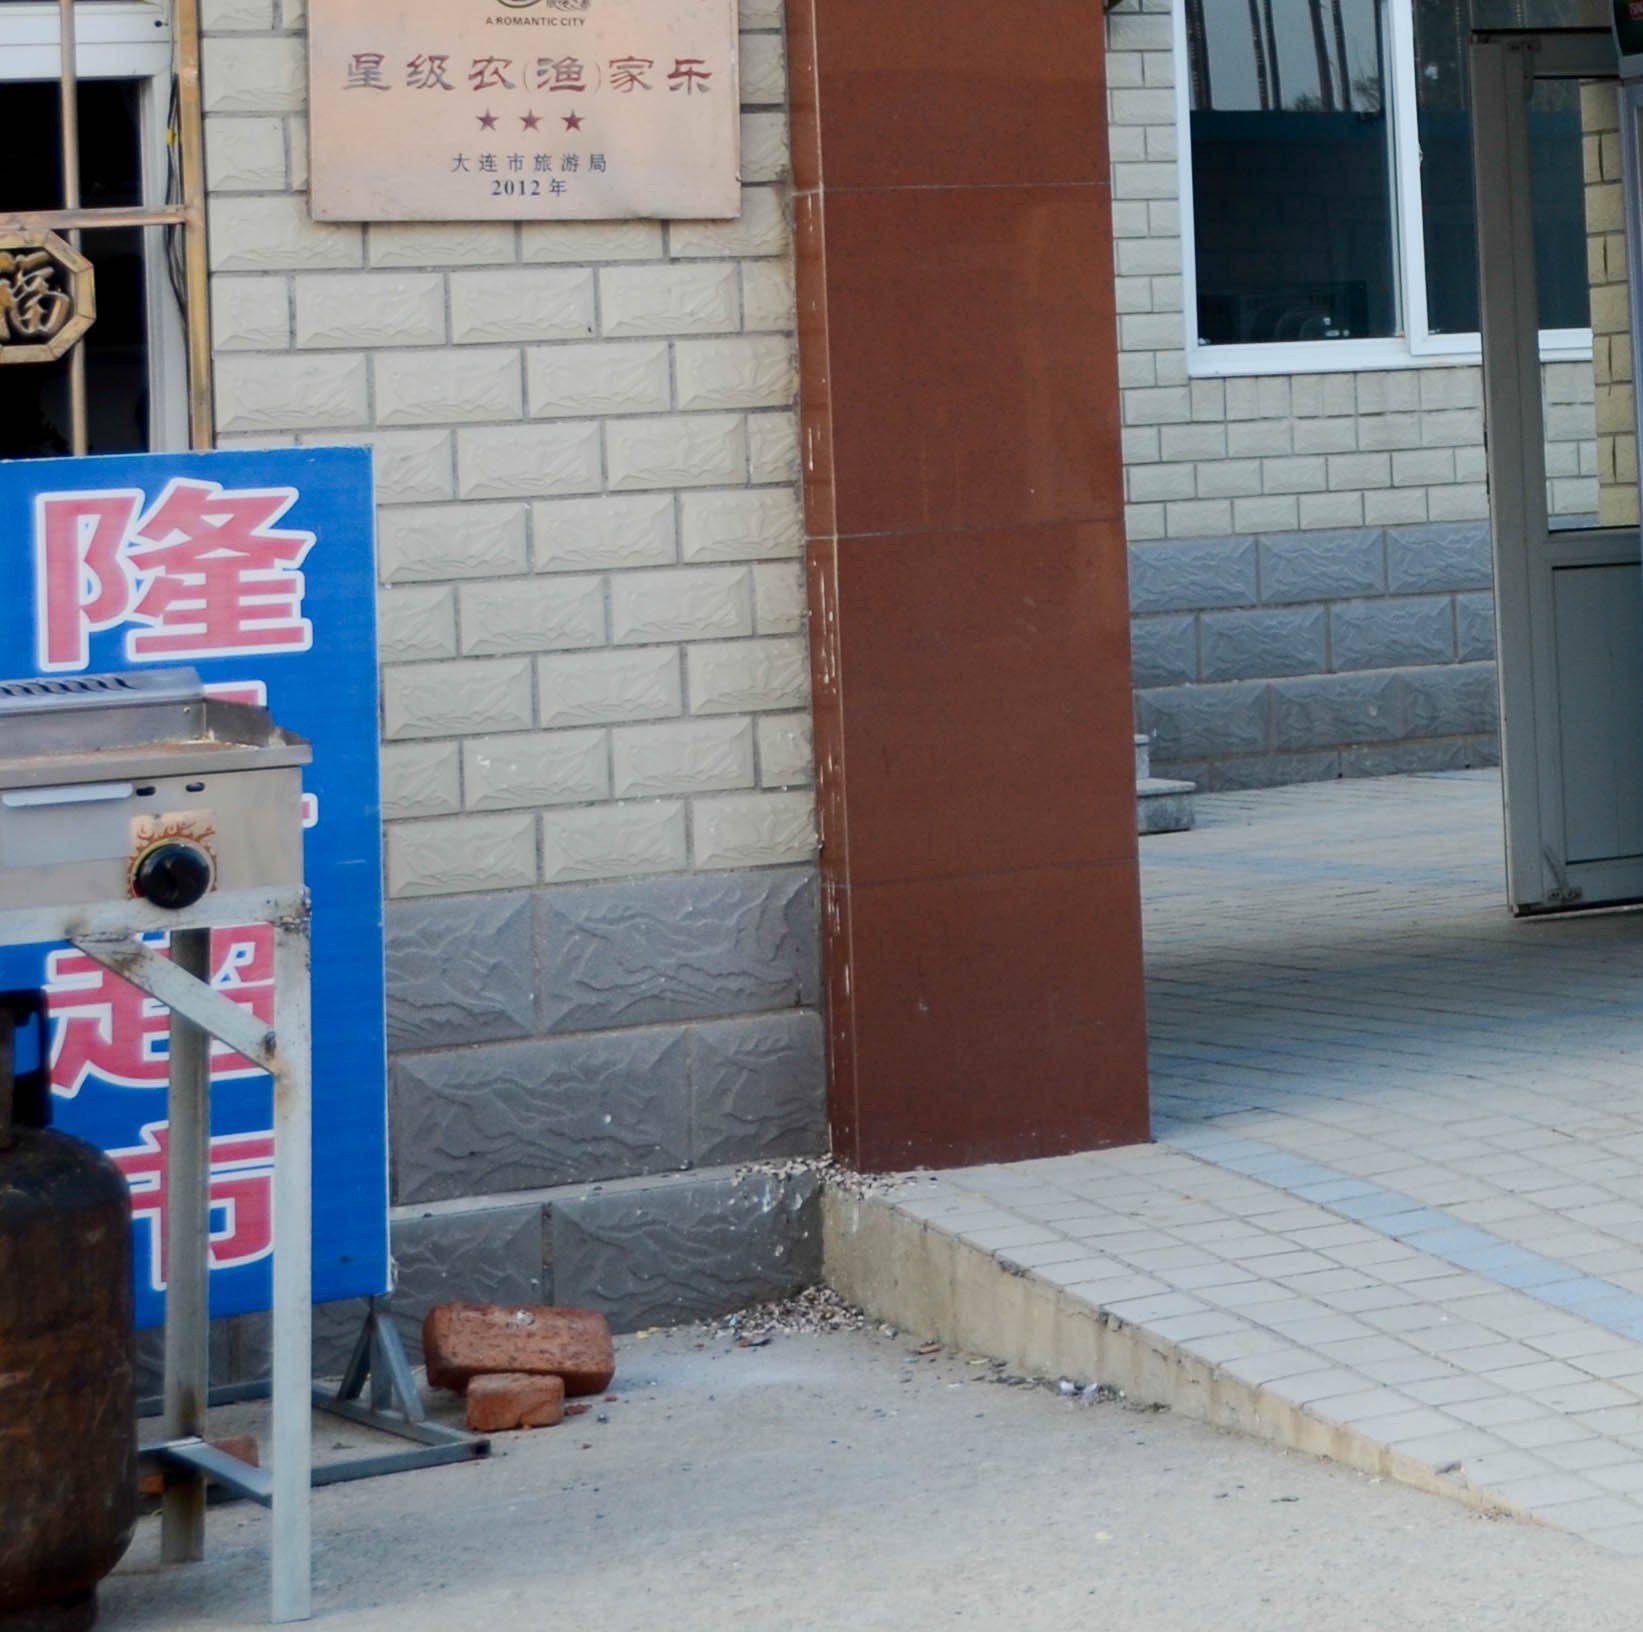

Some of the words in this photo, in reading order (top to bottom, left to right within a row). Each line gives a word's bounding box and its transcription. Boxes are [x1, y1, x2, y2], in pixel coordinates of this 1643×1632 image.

[485, 16, 494, 25] A
[496, 16, 559, 26] ROMANTIC
[560, 17, 586, 27] CITY
[451, 152, 608, 174] 大连市旅游局
